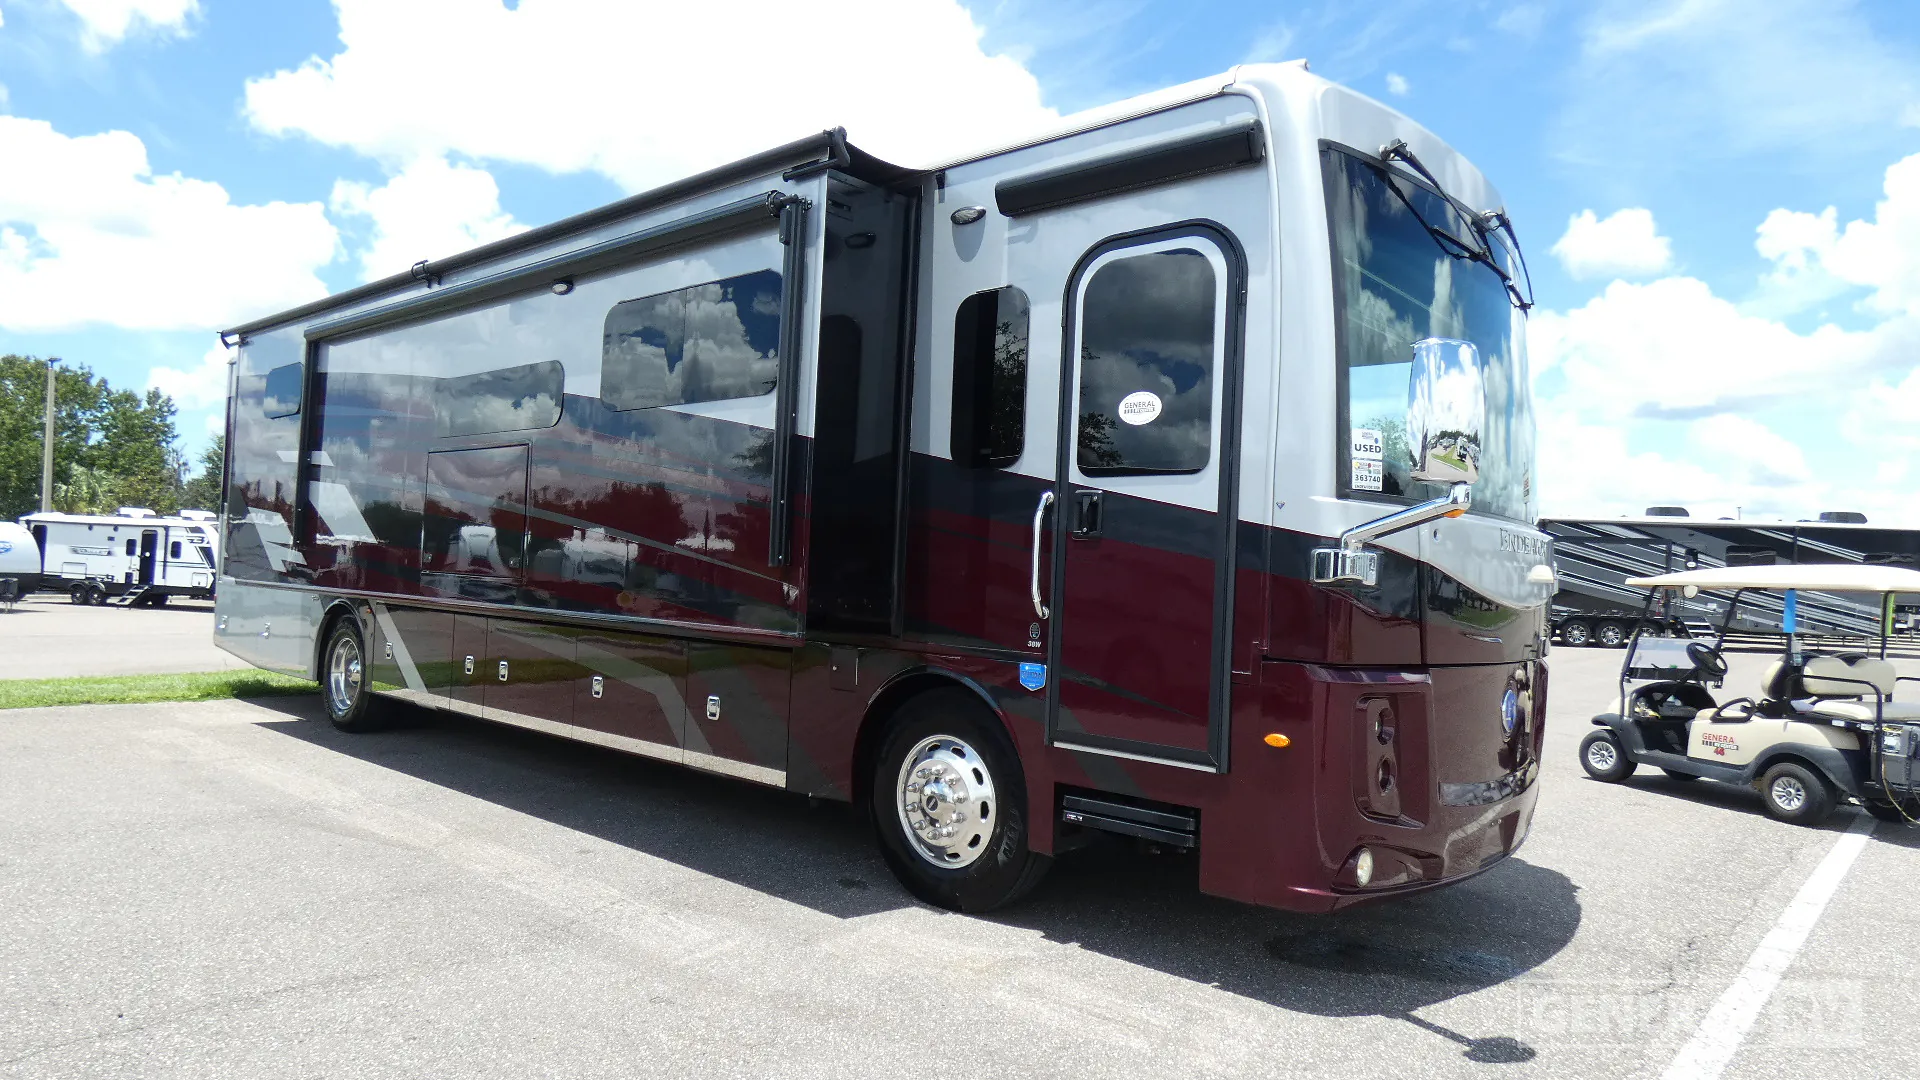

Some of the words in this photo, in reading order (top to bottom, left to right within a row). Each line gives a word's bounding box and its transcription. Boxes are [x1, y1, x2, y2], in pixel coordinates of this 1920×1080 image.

[1124, 401, 1156, 409] GENERAL
[1354, 443, 1382, 453] USED
[1354, 474, 1381, 483] 363740
[1702, 732, 1735, 744] GENERA
